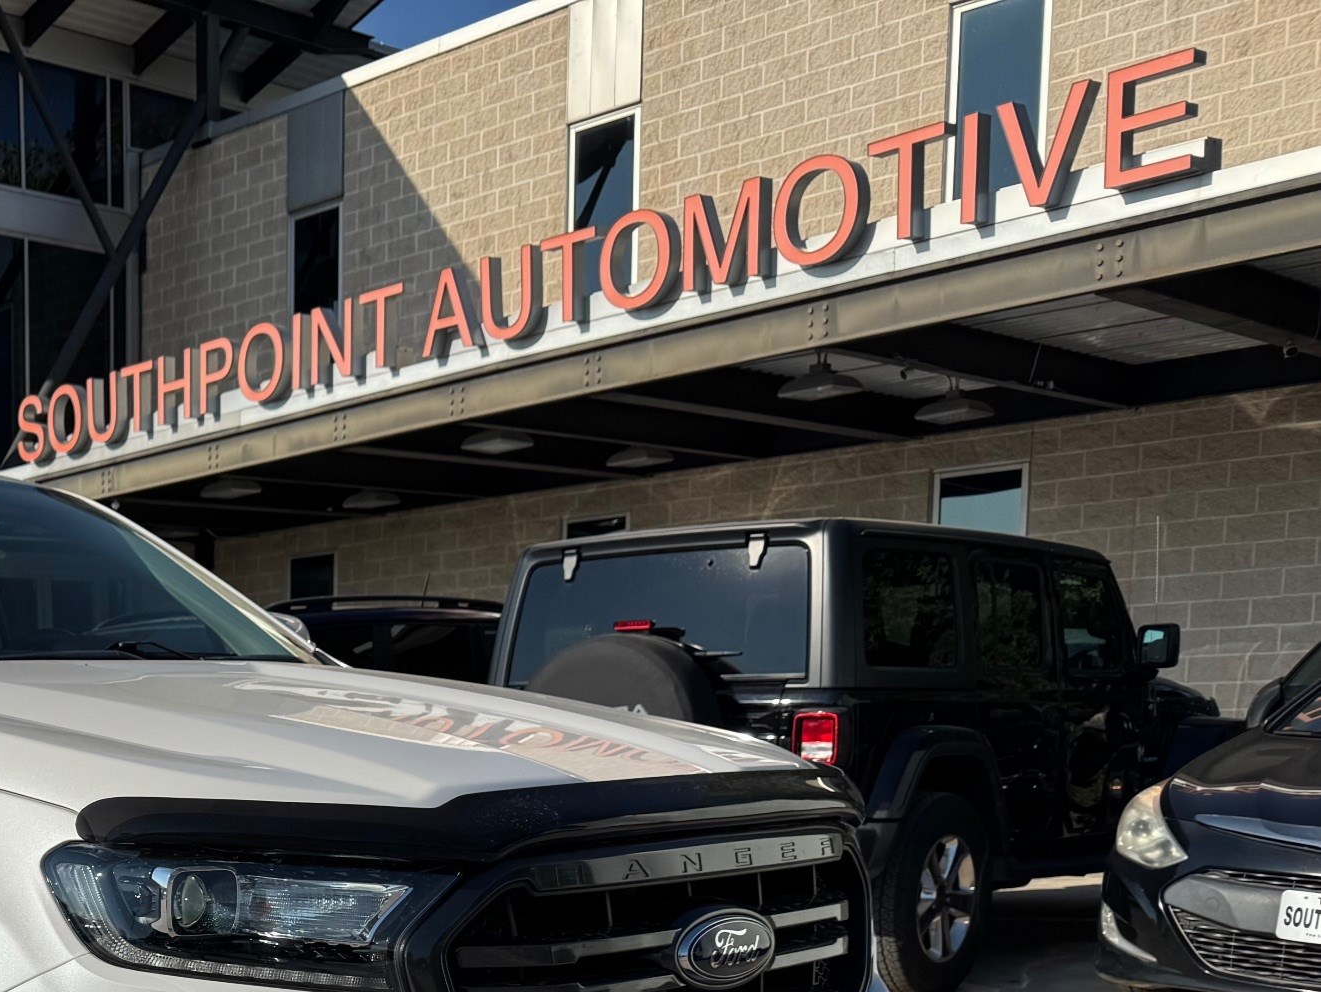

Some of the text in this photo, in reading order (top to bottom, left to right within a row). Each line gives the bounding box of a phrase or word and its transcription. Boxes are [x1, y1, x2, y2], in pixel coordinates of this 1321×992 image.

[17, 47, 1208, 464] SOUTHPOINT AUTOMOTIVE
[710, 927, 760, 968] Ford
